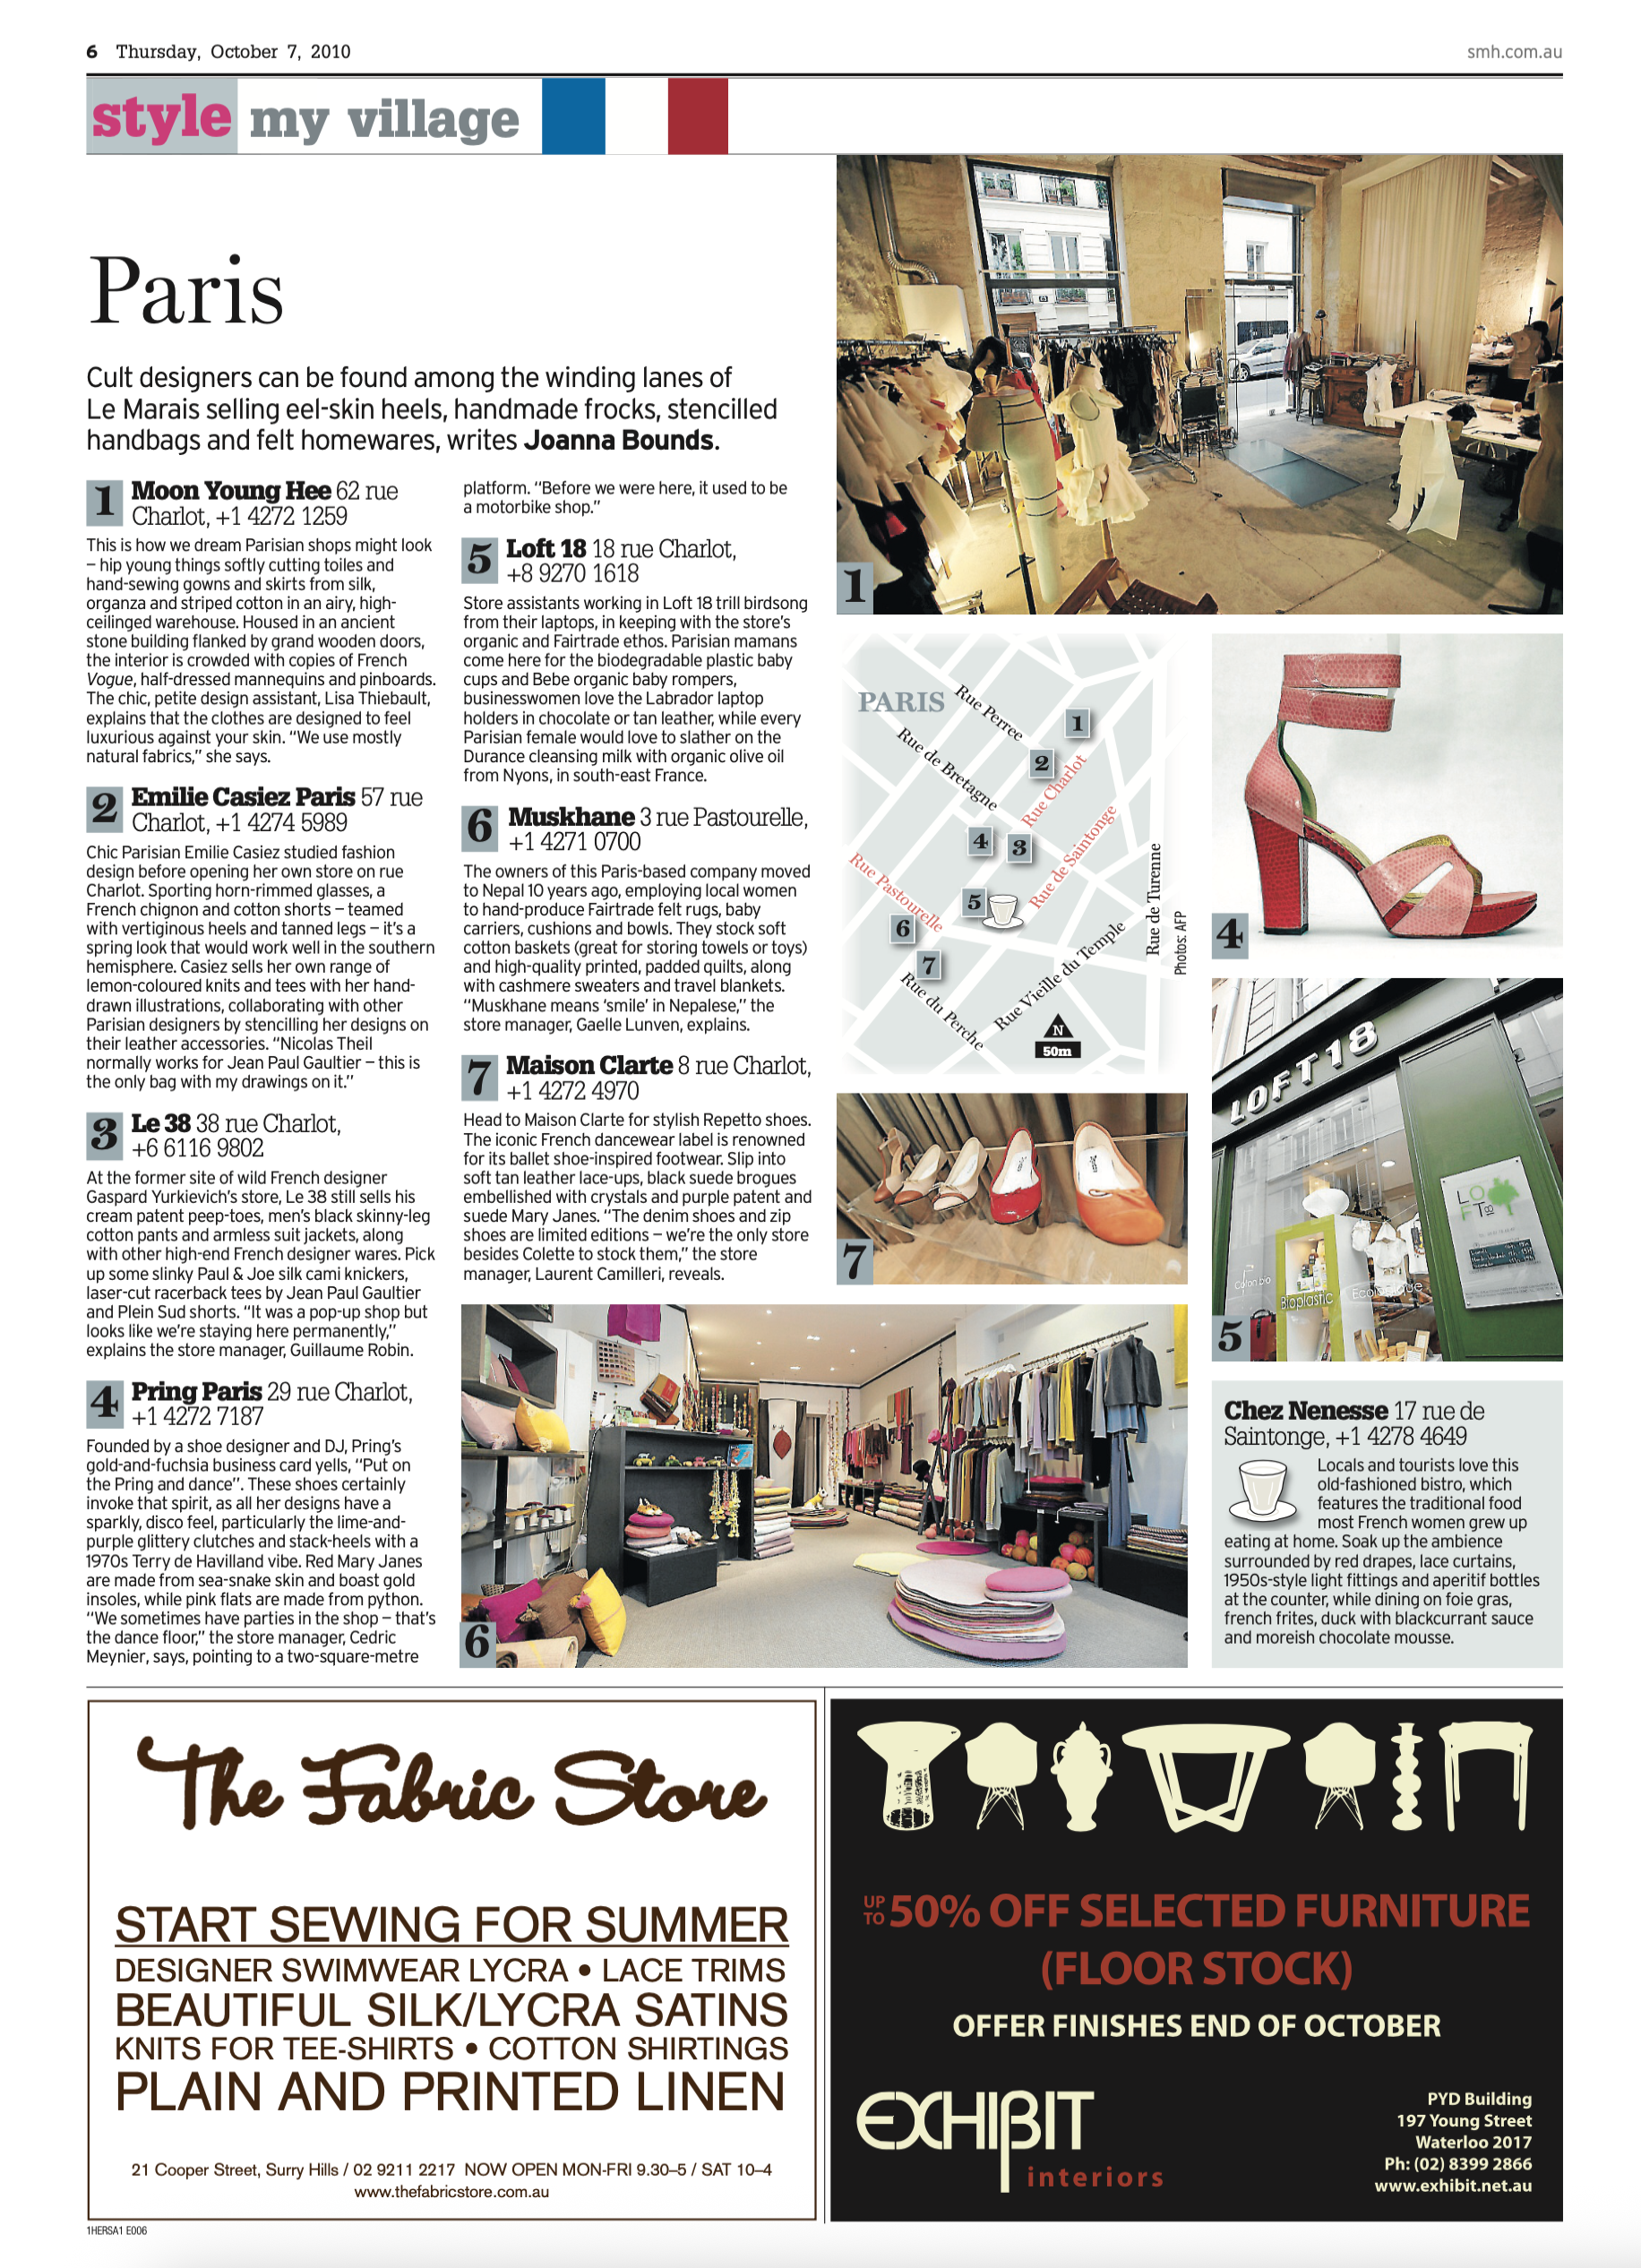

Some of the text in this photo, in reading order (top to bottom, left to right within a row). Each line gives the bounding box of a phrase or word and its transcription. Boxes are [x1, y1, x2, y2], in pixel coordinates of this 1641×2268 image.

[87, 44, 350, 62] 6 Thursday, October 7, 2010
[1468, 45, 1561, 58] smh.com.au
[93, 93, 231, 146] style
[251, 99, 519, 145] my village
[90, 253, 282, 324] Paris
[88, 398, 777, 425] Le Marais selling eel-skin heels, handmade frocks, stencilled
[95, 485, 114, 515] 1
[132, 480, 398, 503] Moon Young Hee 62 rue
[133, 506, 348, 528] Charlot, +1 4272 1259
[468, 544, 492, 573] 5
[507, 537, 735, 561] Loft 18 18 rue Charlot,
[507, 563, 639, 582] +8 9270 1618
[844, 569, 865, 602] 1
[859, 692, 944, 711] PARIS
[954, 684, 1023, 742] Rue Perree
[1072, 716, 1083, 731] 1
[897, 727, 997, 811] Rue de Bretagne
[1035, 756, 1049, 770] 2
[464, 768, 707, 785] from Nyons, in south-east France.
[1020, 754, 1087, 828] Rue Charlot
[92, 793, 117, 822] 2
[509, 806, 807, 829] Muskhane 3 rue Pastourelle,
[468, 809, 492, 842] 6
[974, 834, 988, 848] 4
[1013, 840, 1027, 855] 3
[1028, 806, 1117, 909] Rue de Saintonge
[848, 852, 943, 932] Rue Pastourelle
[968, 895, 981, 909] 5
[1146, 843, 1161, 956] Rue de Turenne
[897, 920, 909, 937] 6
[1216, 919, 1242, 949] 4
[1174, 911, 1186, 975] Photos: AFP
[923, 957, 935, 975] 7
[993, 922, 1126, 1031] Rue Vieille du Temple
[900, 972, 984, 1051] Rue du Perche
[1052, 1025, 1064, 1035] N
[1044, 1046, 1072, 1056] 50m
[468, 1059, 491, 1095] 7
[91, 1118, 117, 1150] 3
[844, 1243, 866, 1279] 7
[464, 1267, 724, 1284] manager, Laurent Camilleri, reveals.
[1281, 1290, 1334, 1310] Bioplastic
[1218, 1321, 1242, 1352] 5
[87, 1343, 413, 1360] explains the store manager, Guillaume Robin.
[90, 1386, 118, 1417] 4
[1224, 1400, 1484, 1421] Chez Nenesse 17 rue de
[86, 1554, 422, 1571] 1970s Terry de Havilland vibe. Red Mary Janes
[465, 1624, 489, 1658] 6
[1224, 1630, 1454, 1644] and moreish chocolate mousse.
[137, 1736, 768, 1830] The Fabric Store
[864, 1895, 885, 1908] UP
[890, 1894, 1530, 1927] 50% OFF SELECTED FURNITURE
[116, 1905, 788, 1943] START SEWING FOR SUMMER
[863, 1912, 884, 1925] TO
[1043, 1951, 1352, 1990] (FLOOR STOCK)
[856, 2090, 1095, 2193] EXHIBIT
[1028, 2166, 1163, 2186] interiors
[1386, 2157, 1532, 2172] Ph: (02) 8399 2866
[355, 2185, 549, 2197] www.thefabricstore.com.au
[1375, 2178, 1532, 2192] www.exhibit.net.au
[87, 2226, 147, 2235] 1HERSA1 E006
